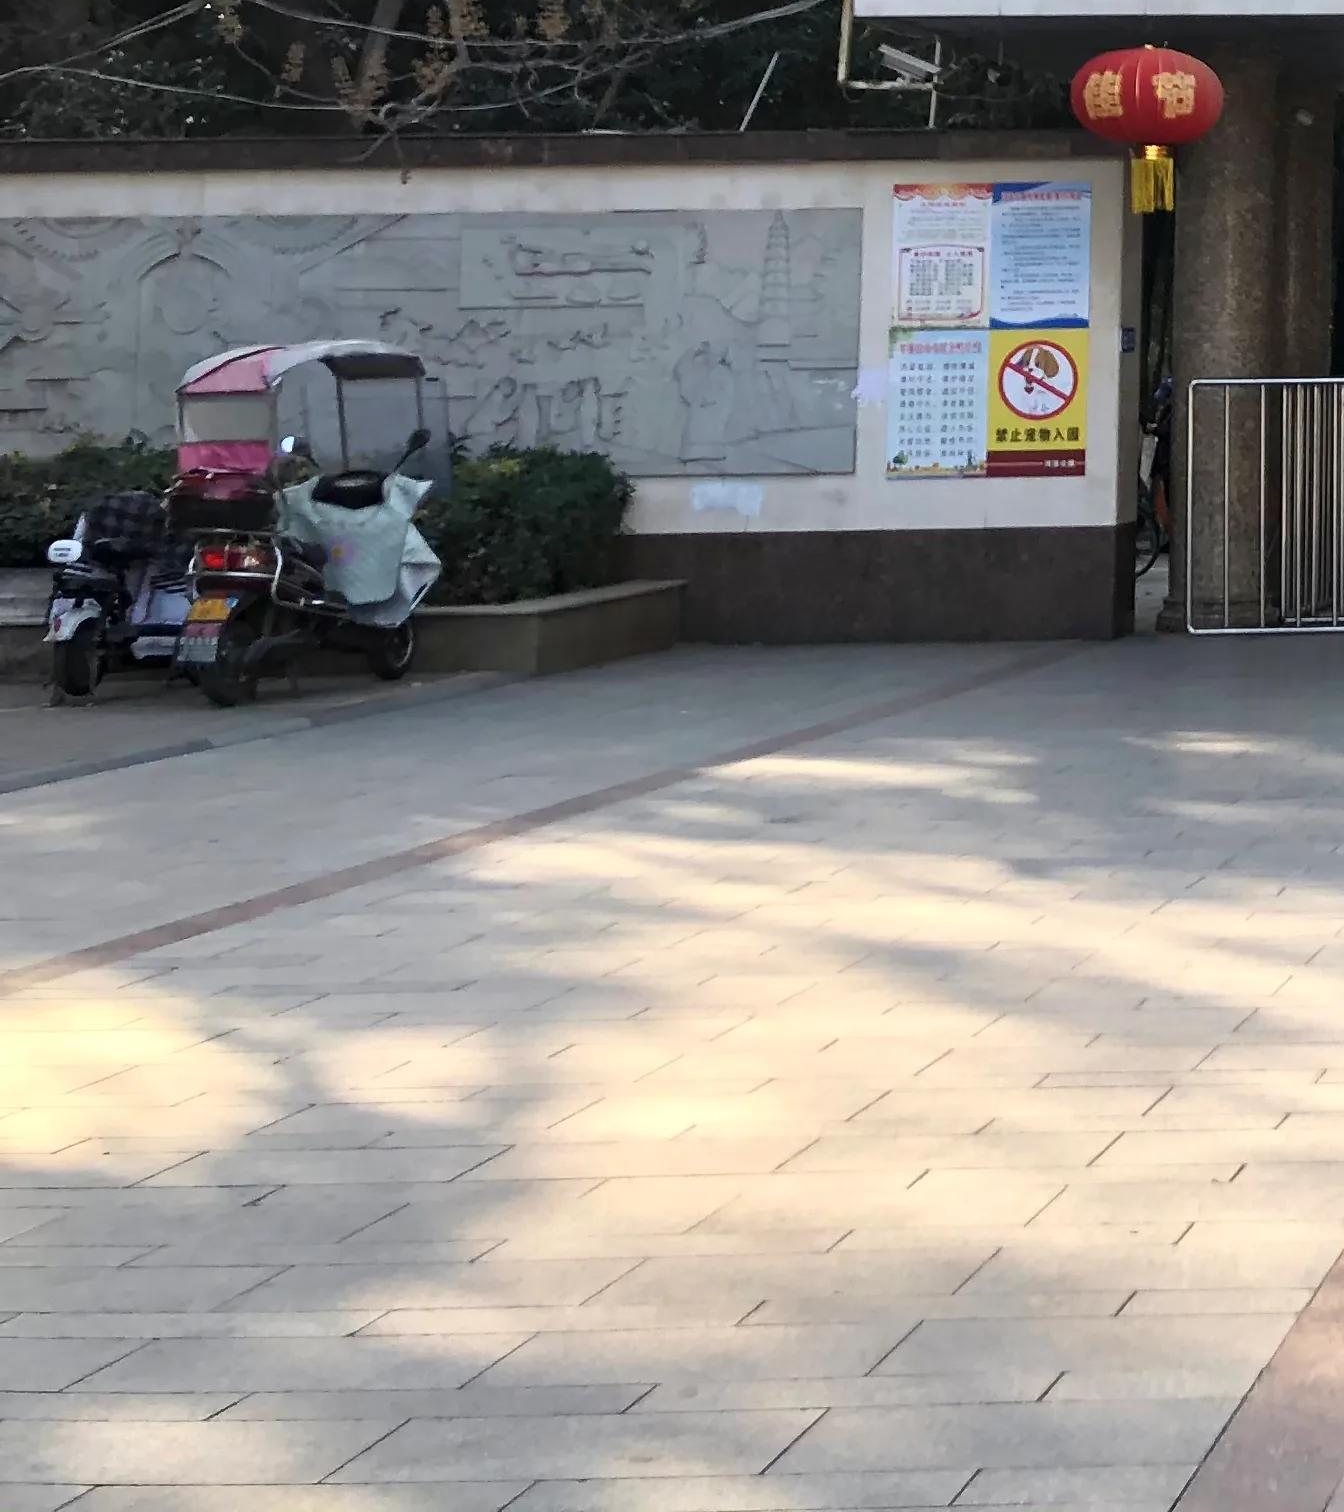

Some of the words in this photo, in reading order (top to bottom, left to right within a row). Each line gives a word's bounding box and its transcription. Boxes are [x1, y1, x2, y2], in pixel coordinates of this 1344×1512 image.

[995, 426, 1080, 442] 禁止宠物入园
